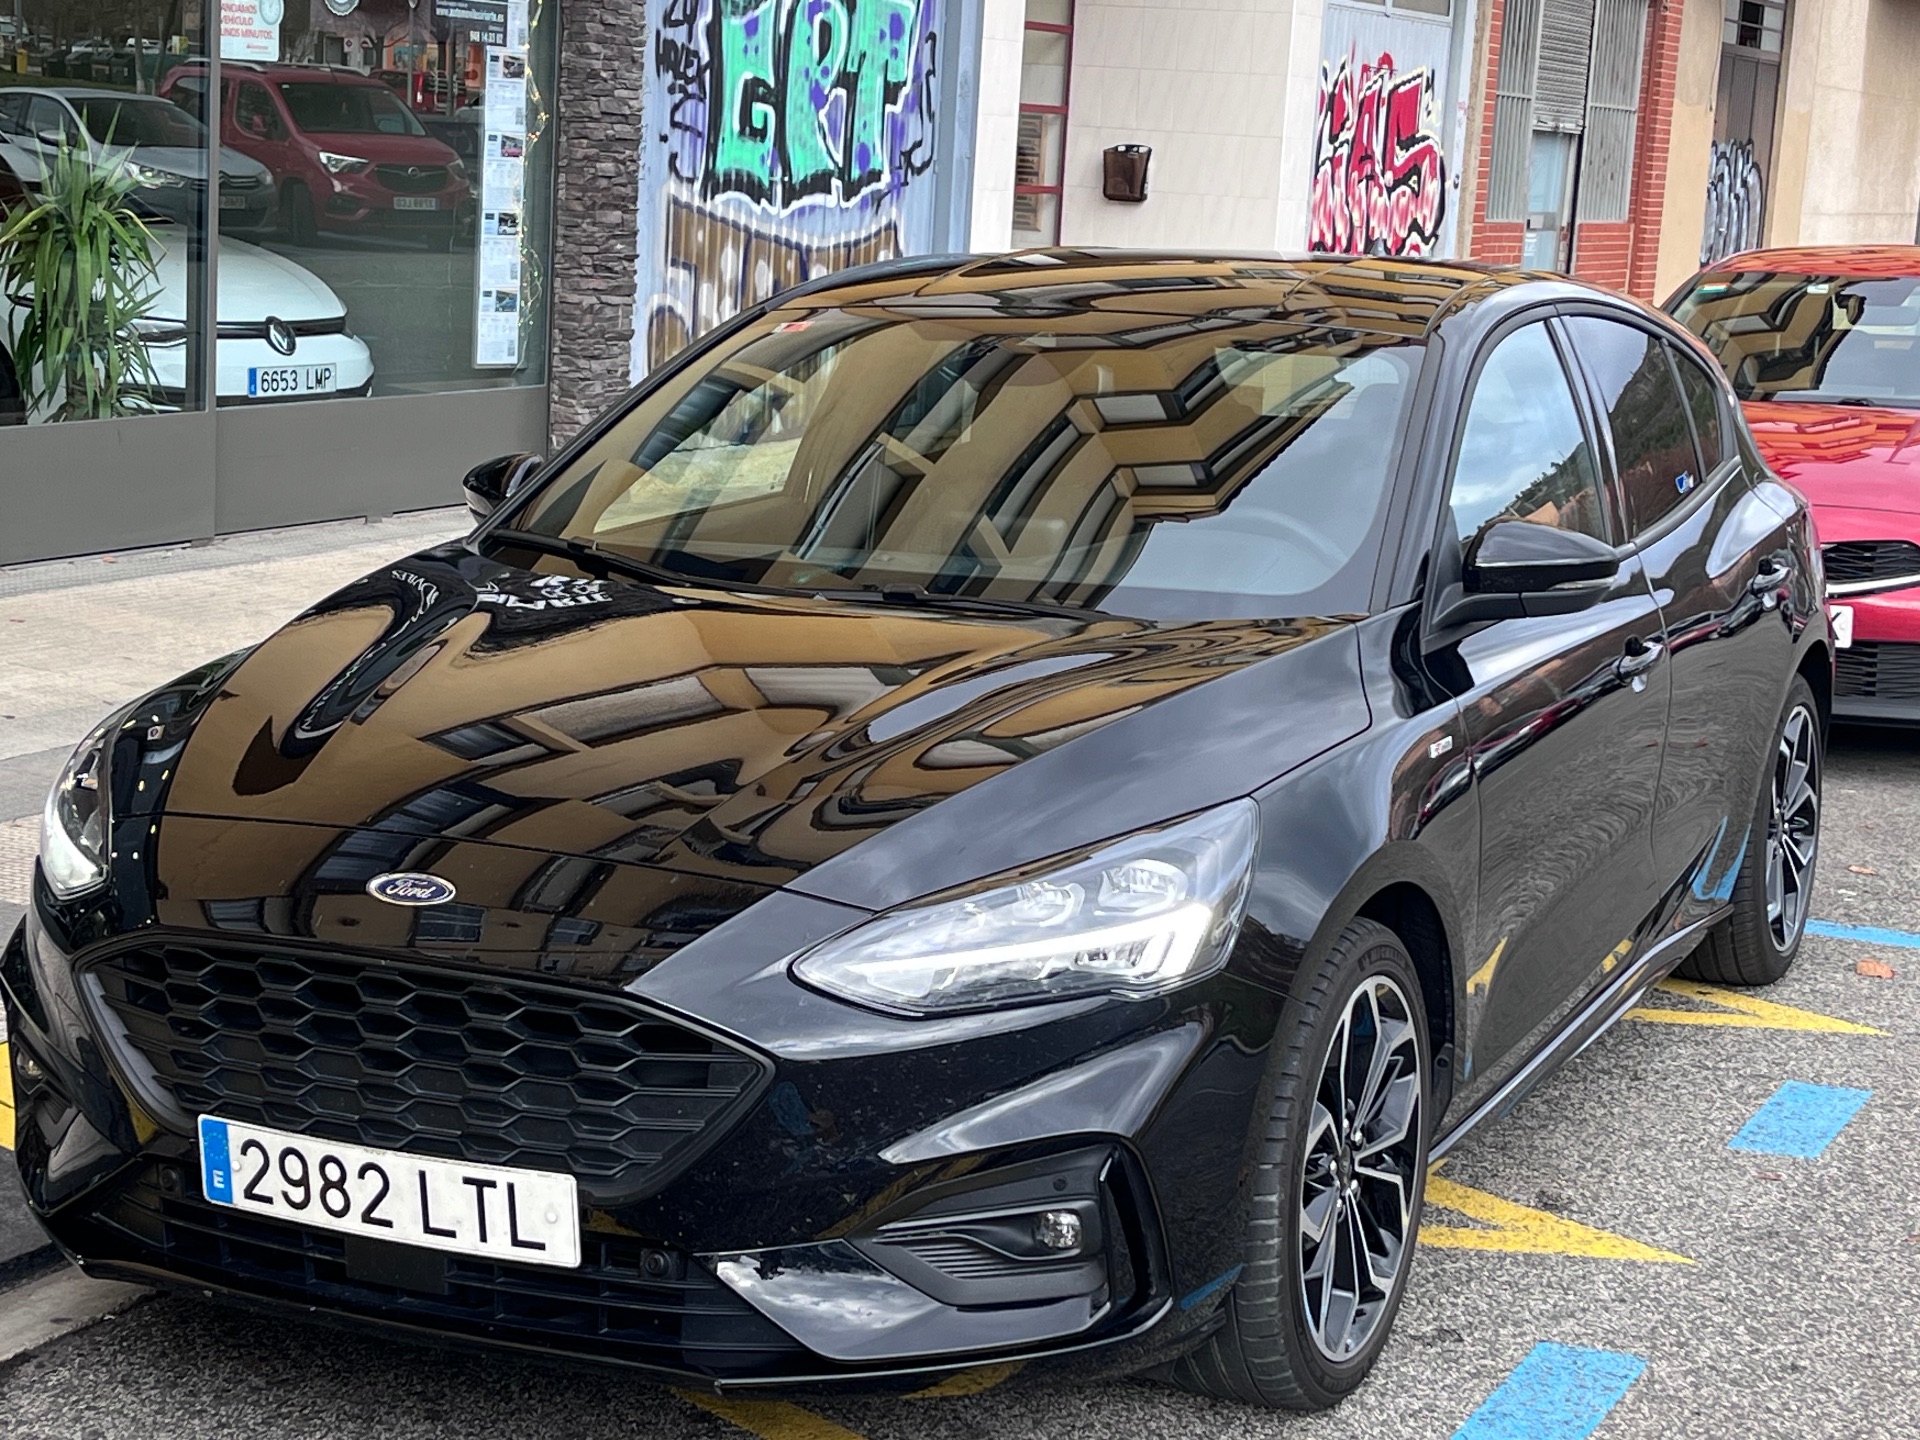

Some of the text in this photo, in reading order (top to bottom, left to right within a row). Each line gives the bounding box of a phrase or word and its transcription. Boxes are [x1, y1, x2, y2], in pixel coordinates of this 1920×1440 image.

[261, 367, 332, 393] 6653 LMP
[386, 878, 437, 899] Ford
[213, 1137, 547, 1252] E 2982 LTL
